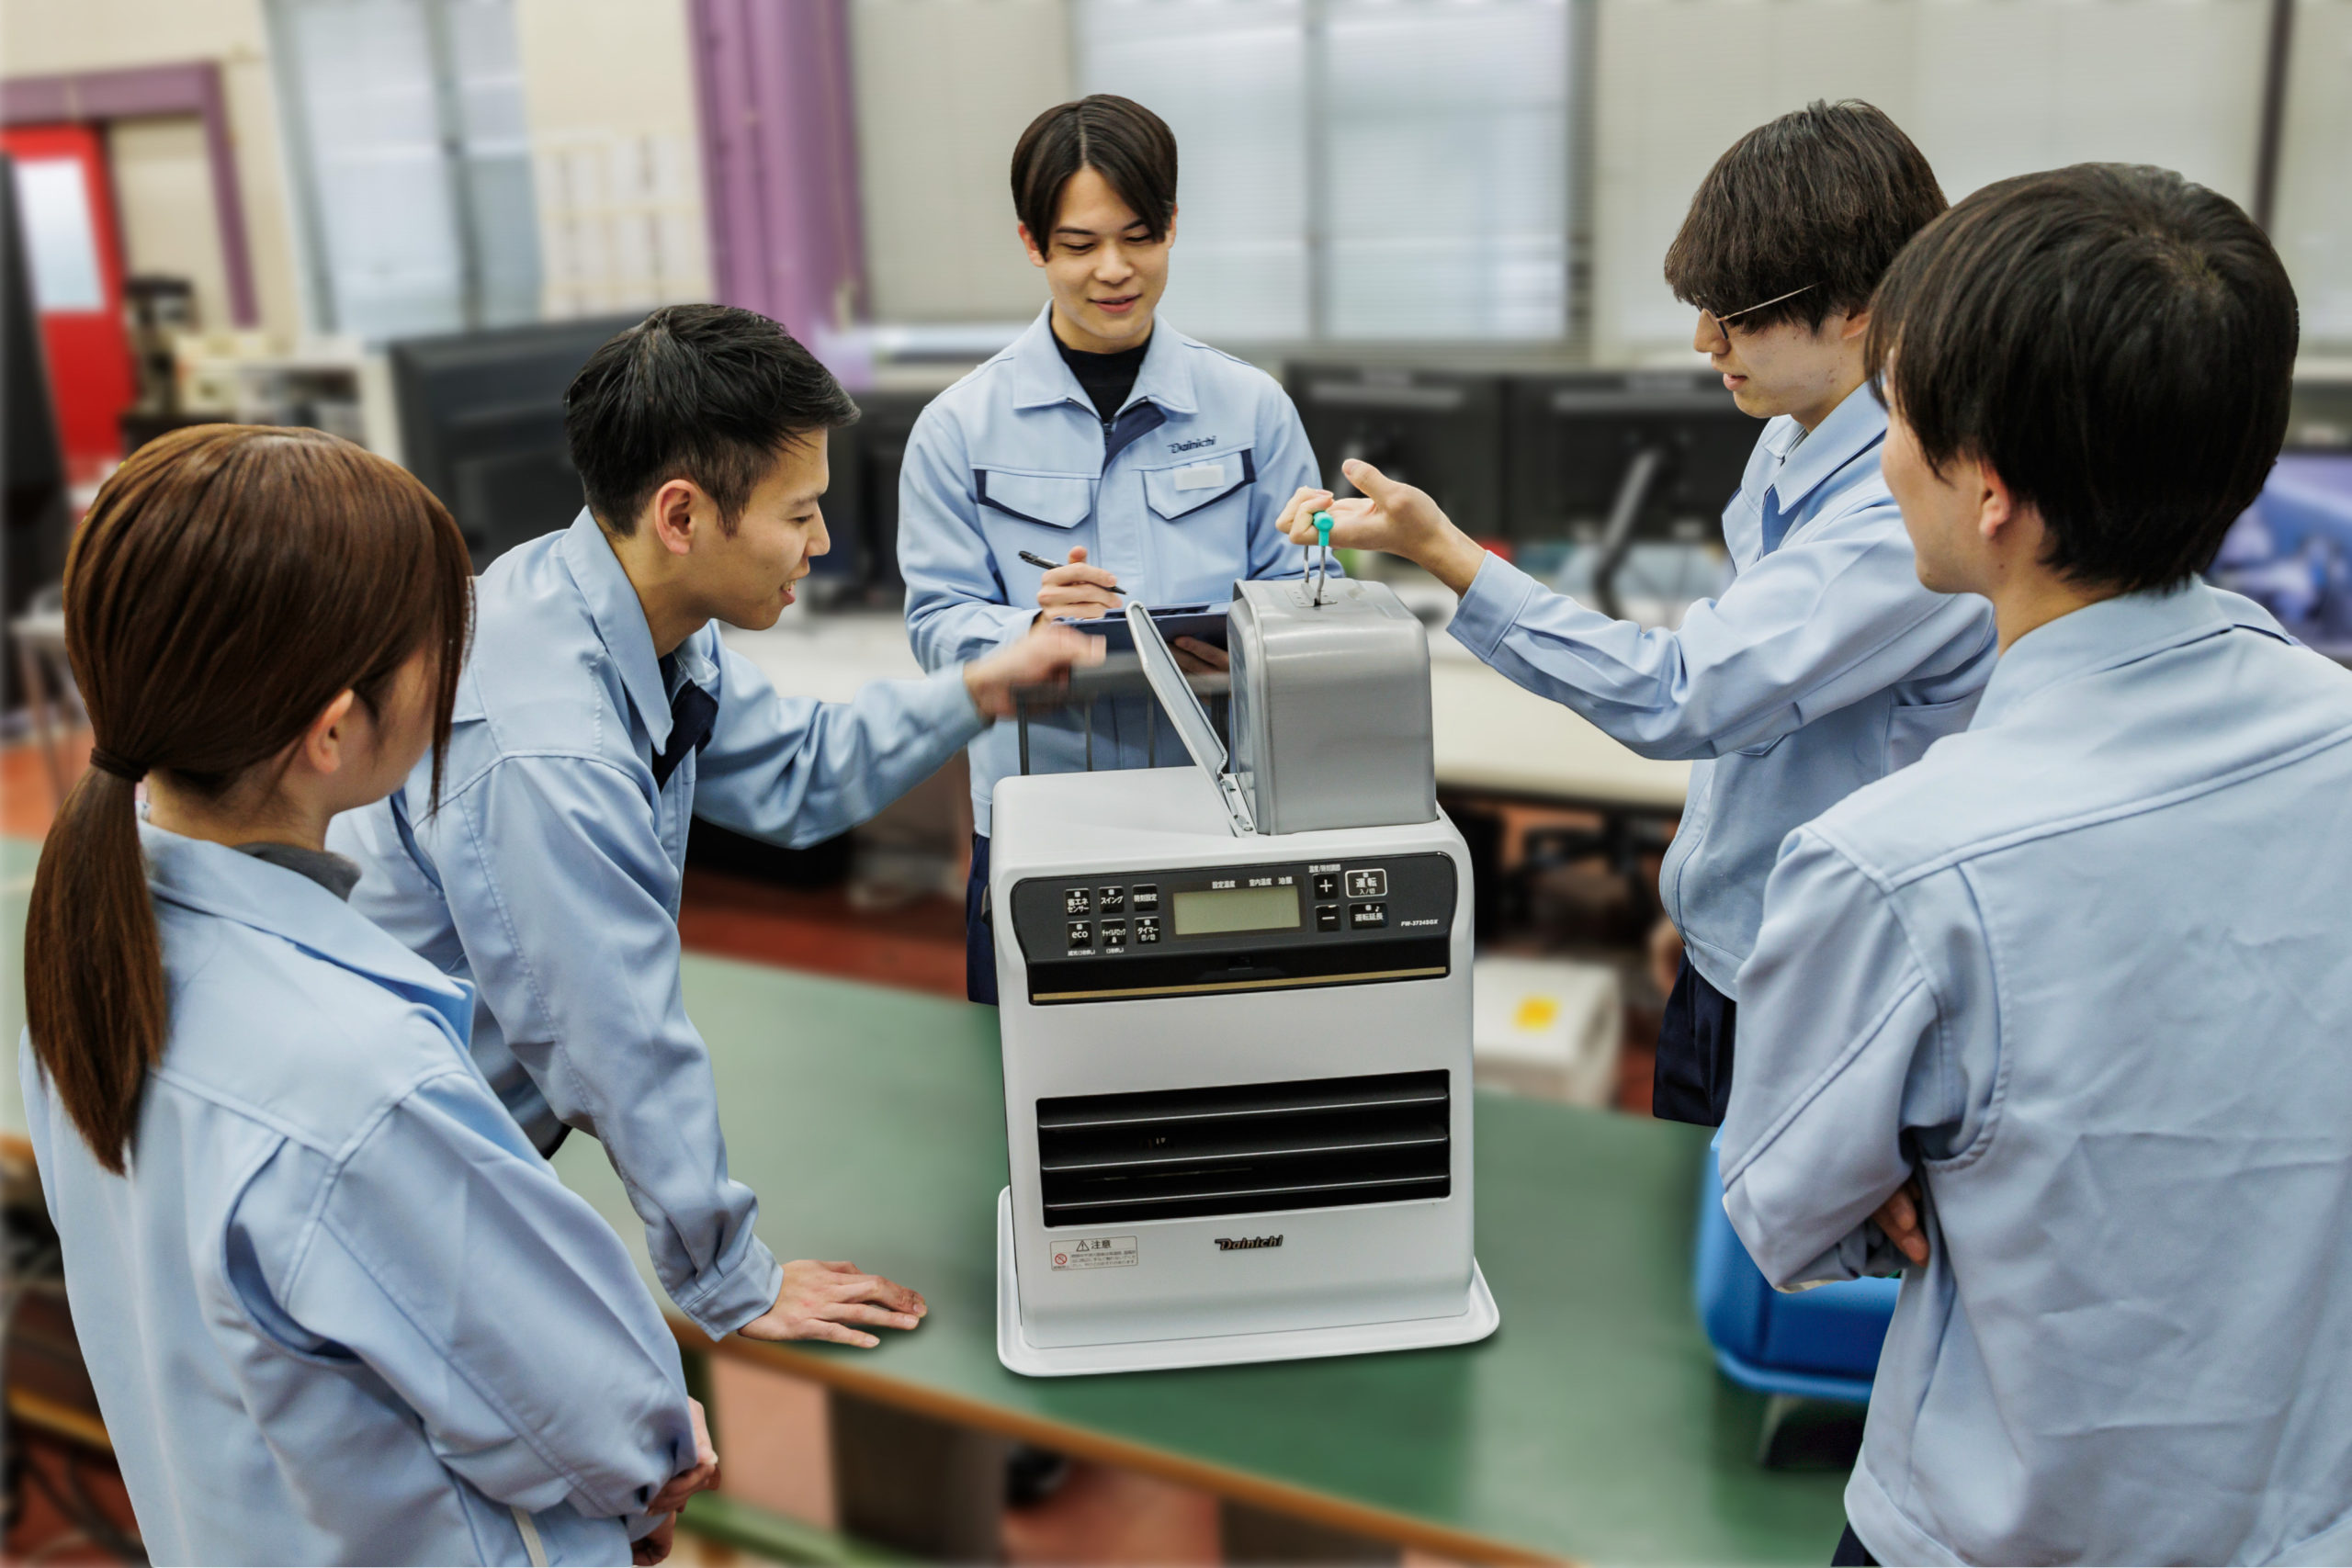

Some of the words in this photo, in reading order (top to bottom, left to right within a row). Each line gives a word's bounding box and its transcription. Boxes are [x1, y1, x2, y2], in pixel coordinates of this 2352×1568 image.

[1167, 435, 1216, 454] Dainichi
[1355, 877, 1377, 887] 運転
[1067, 898, 1089, 908] 省エネ
[1101, 896, 1124, 905] スイング
[1071, 931, 1089, 939] eco
[1136, 927, 1159, 935] タイマー
[1091, 1239, 1112, 1250] 注意
[1214, 1235, 1284, 1251] Dainichi
